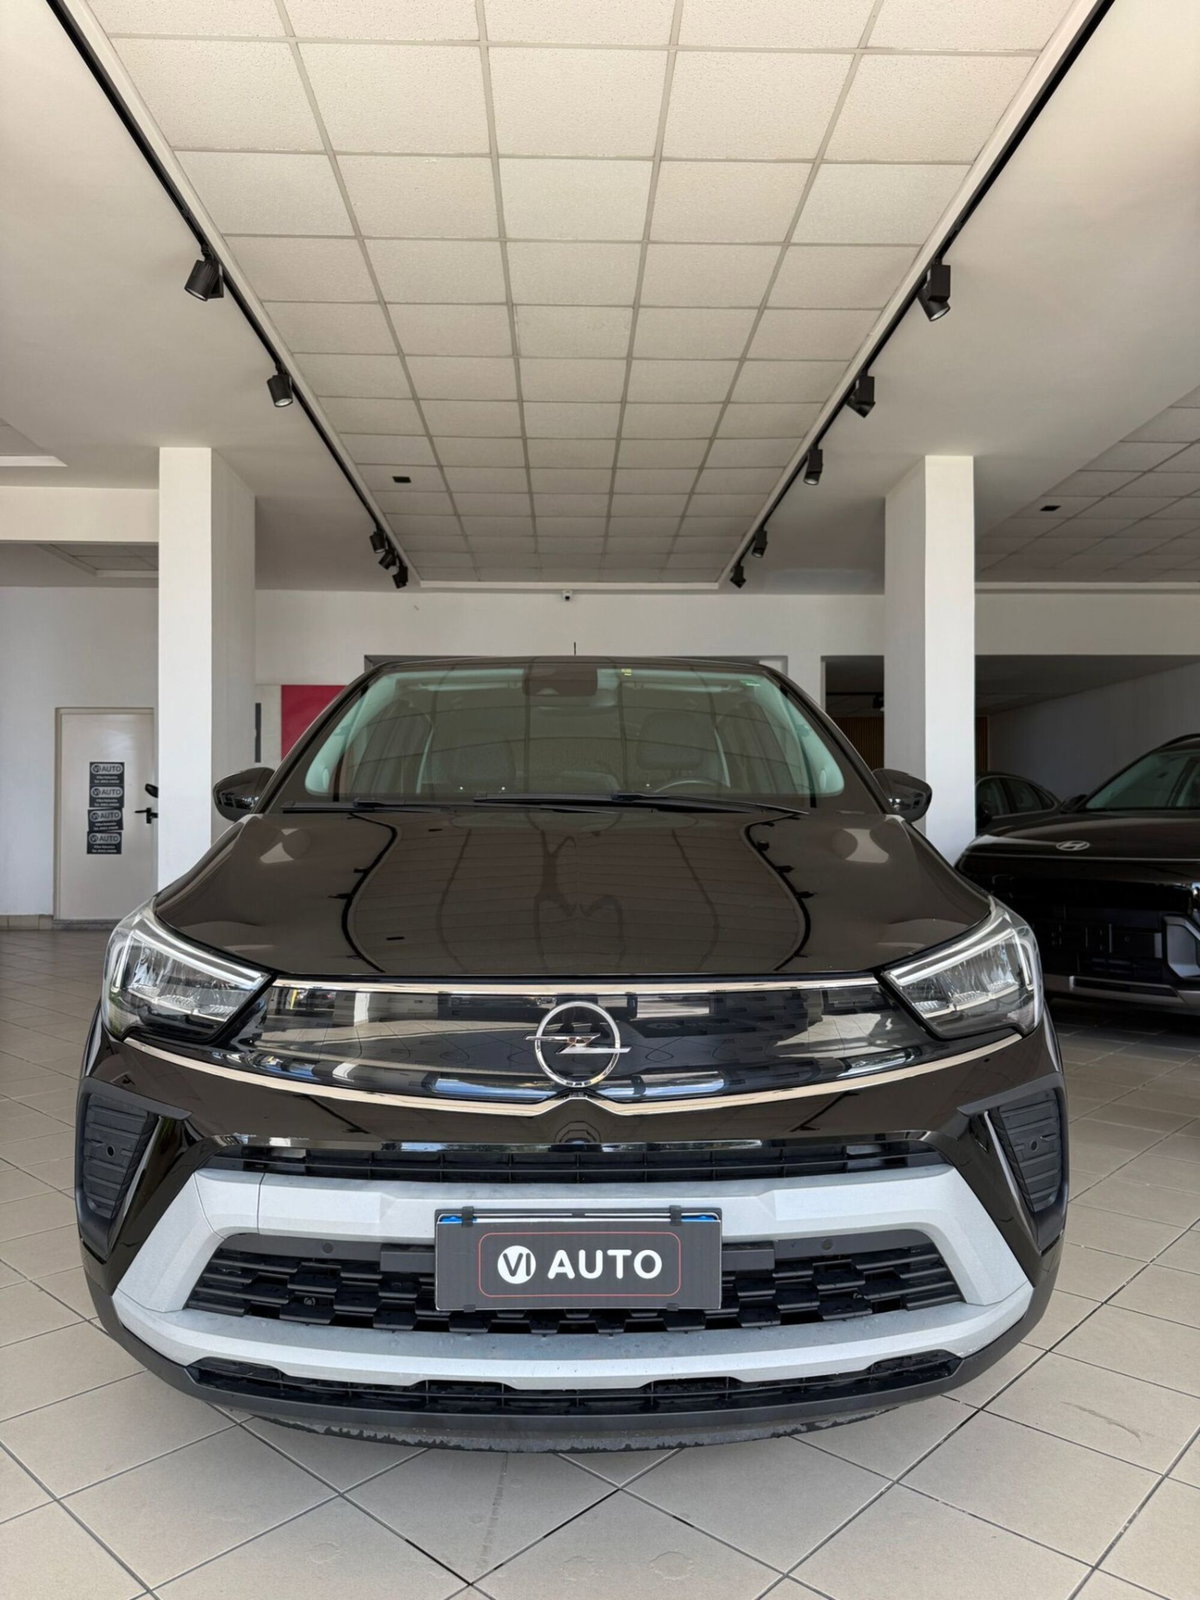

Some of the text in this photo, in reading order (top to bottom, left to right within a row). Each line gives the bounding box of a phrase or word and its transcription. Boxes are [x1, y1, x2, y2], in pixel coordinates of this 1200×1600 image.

[101, 765, 122, 773] AUTO
[101, 788, 122, 796] AUTO
[100, 811, 120, 820] AUTO
[99, 835, 119, 843] AUTO
[547, 1249, 663, 1280] AUTO
